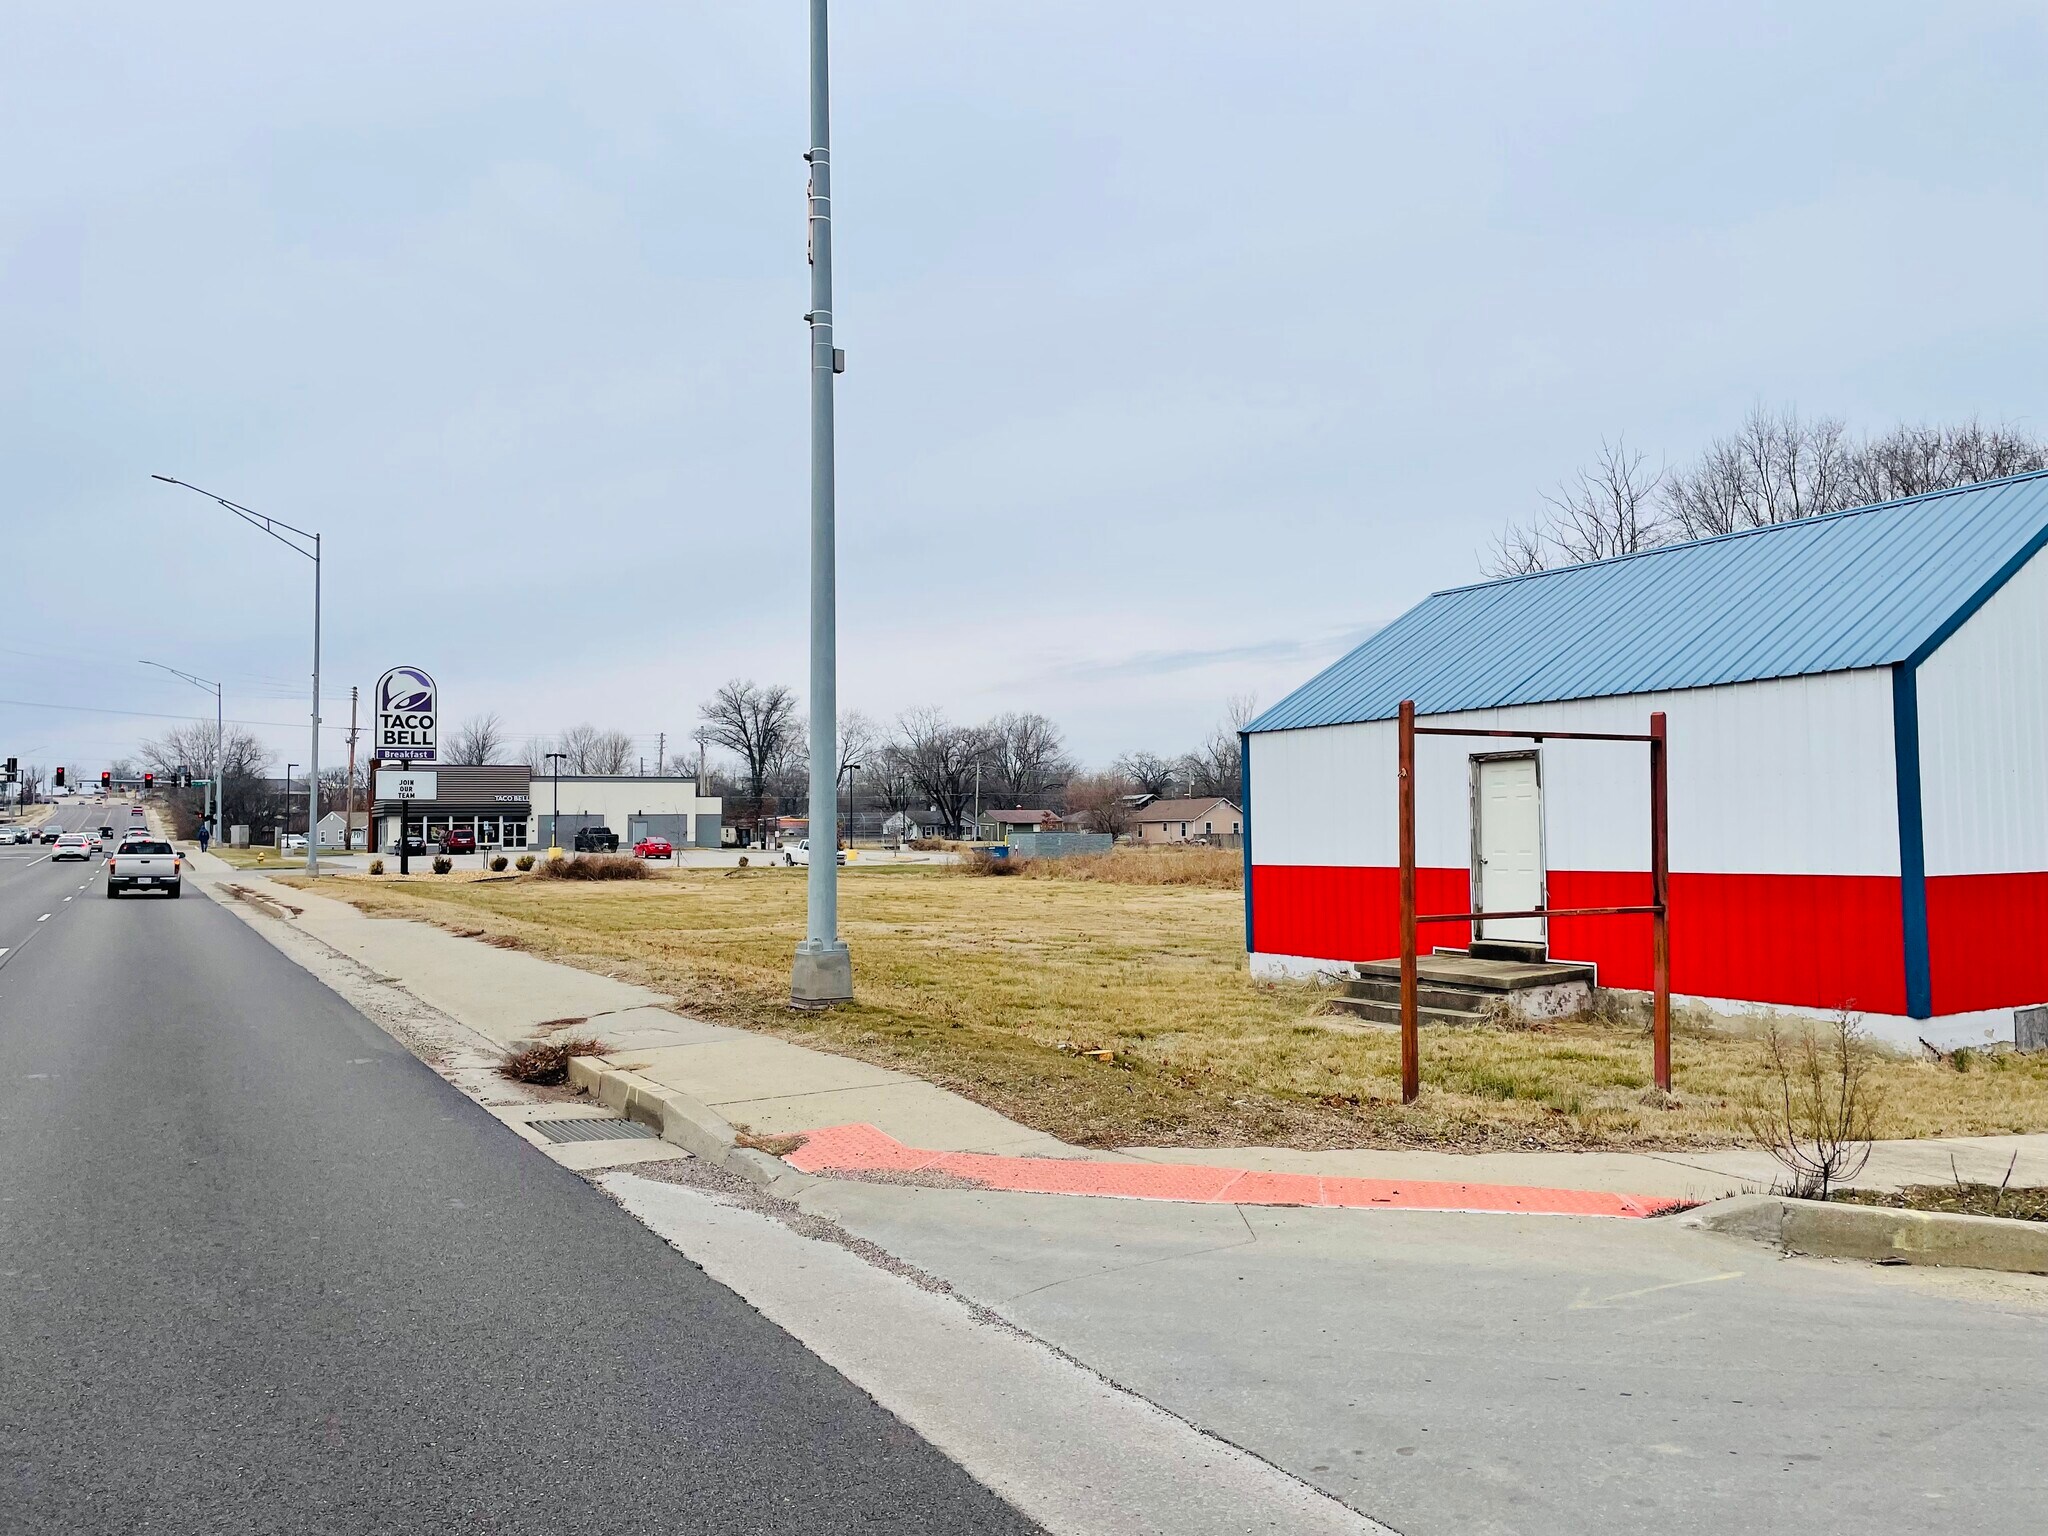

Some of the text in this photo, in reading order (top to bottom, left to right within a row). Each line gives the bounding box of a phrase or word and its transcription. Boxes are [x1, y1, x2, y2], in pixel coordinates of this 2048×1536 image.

[380, 714, 434, 729] TACO
[383, 730, 433, 745] BELL
[384, 750, 428, 758] Breakfast
